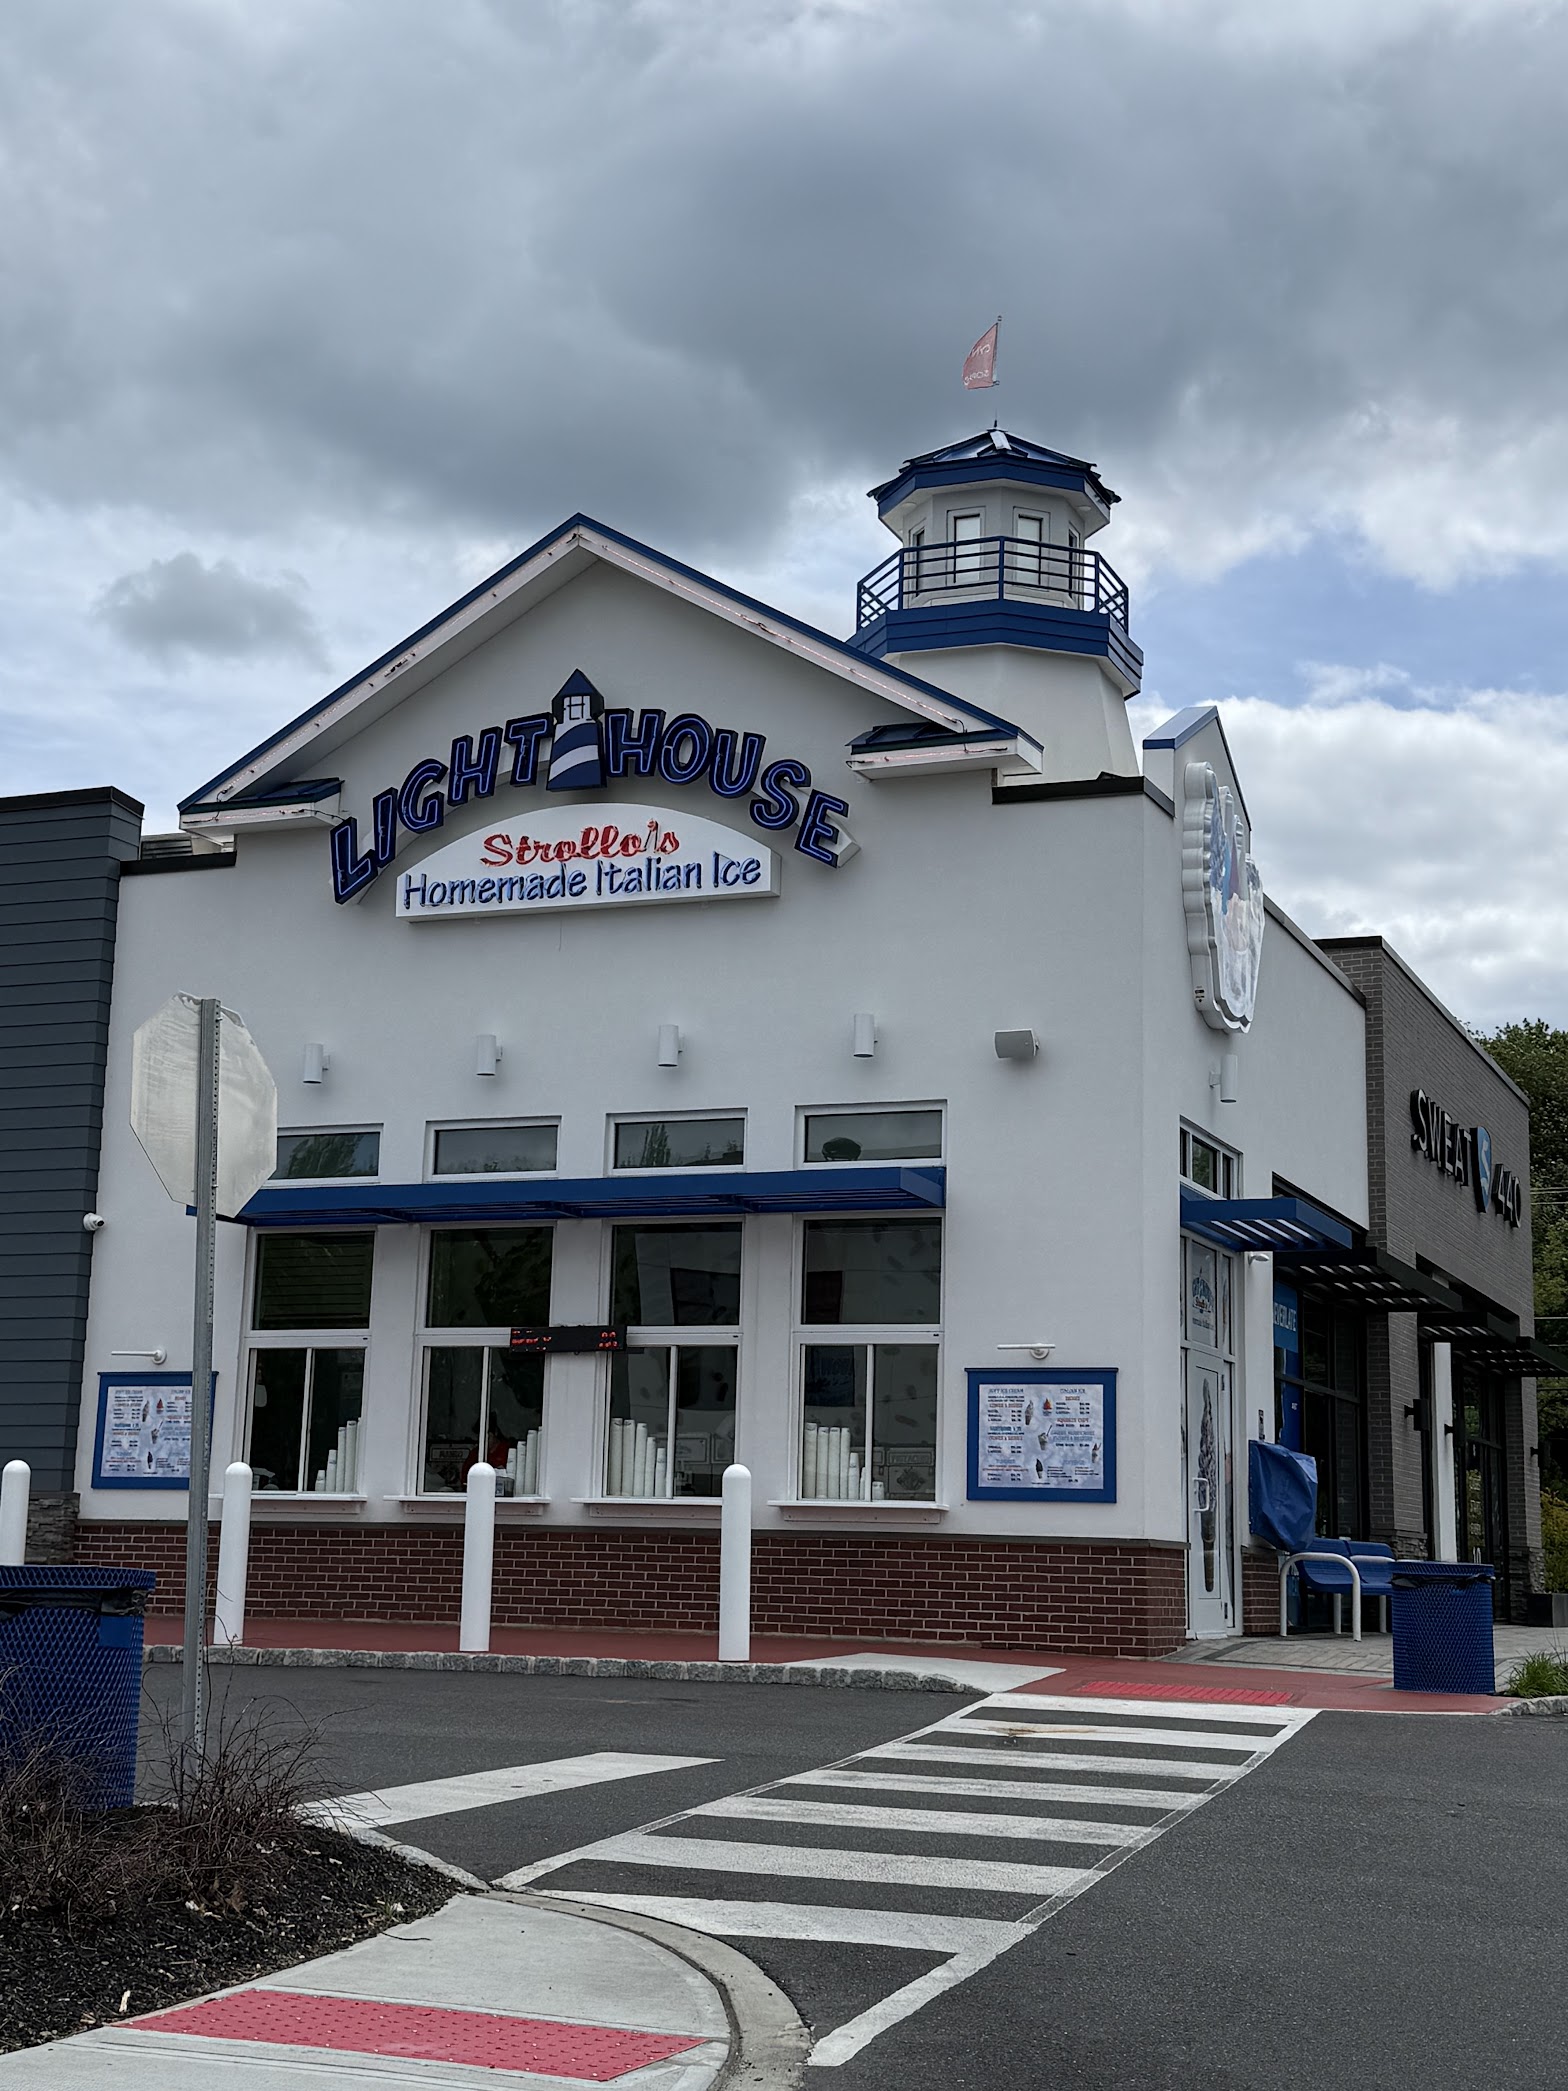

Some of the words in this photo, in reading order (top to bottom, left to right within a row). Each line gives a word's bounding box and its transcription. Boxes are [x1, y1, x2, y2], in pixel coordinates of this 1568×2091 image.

[480, 818, 680, 867] Strollo's
[403, 862, 588, 910] Homemade
[595, 856, 703, 896] Italian
[713, 851, 761, 888] Ice
[1410, 1088, 1472, 1186] SWEAT
